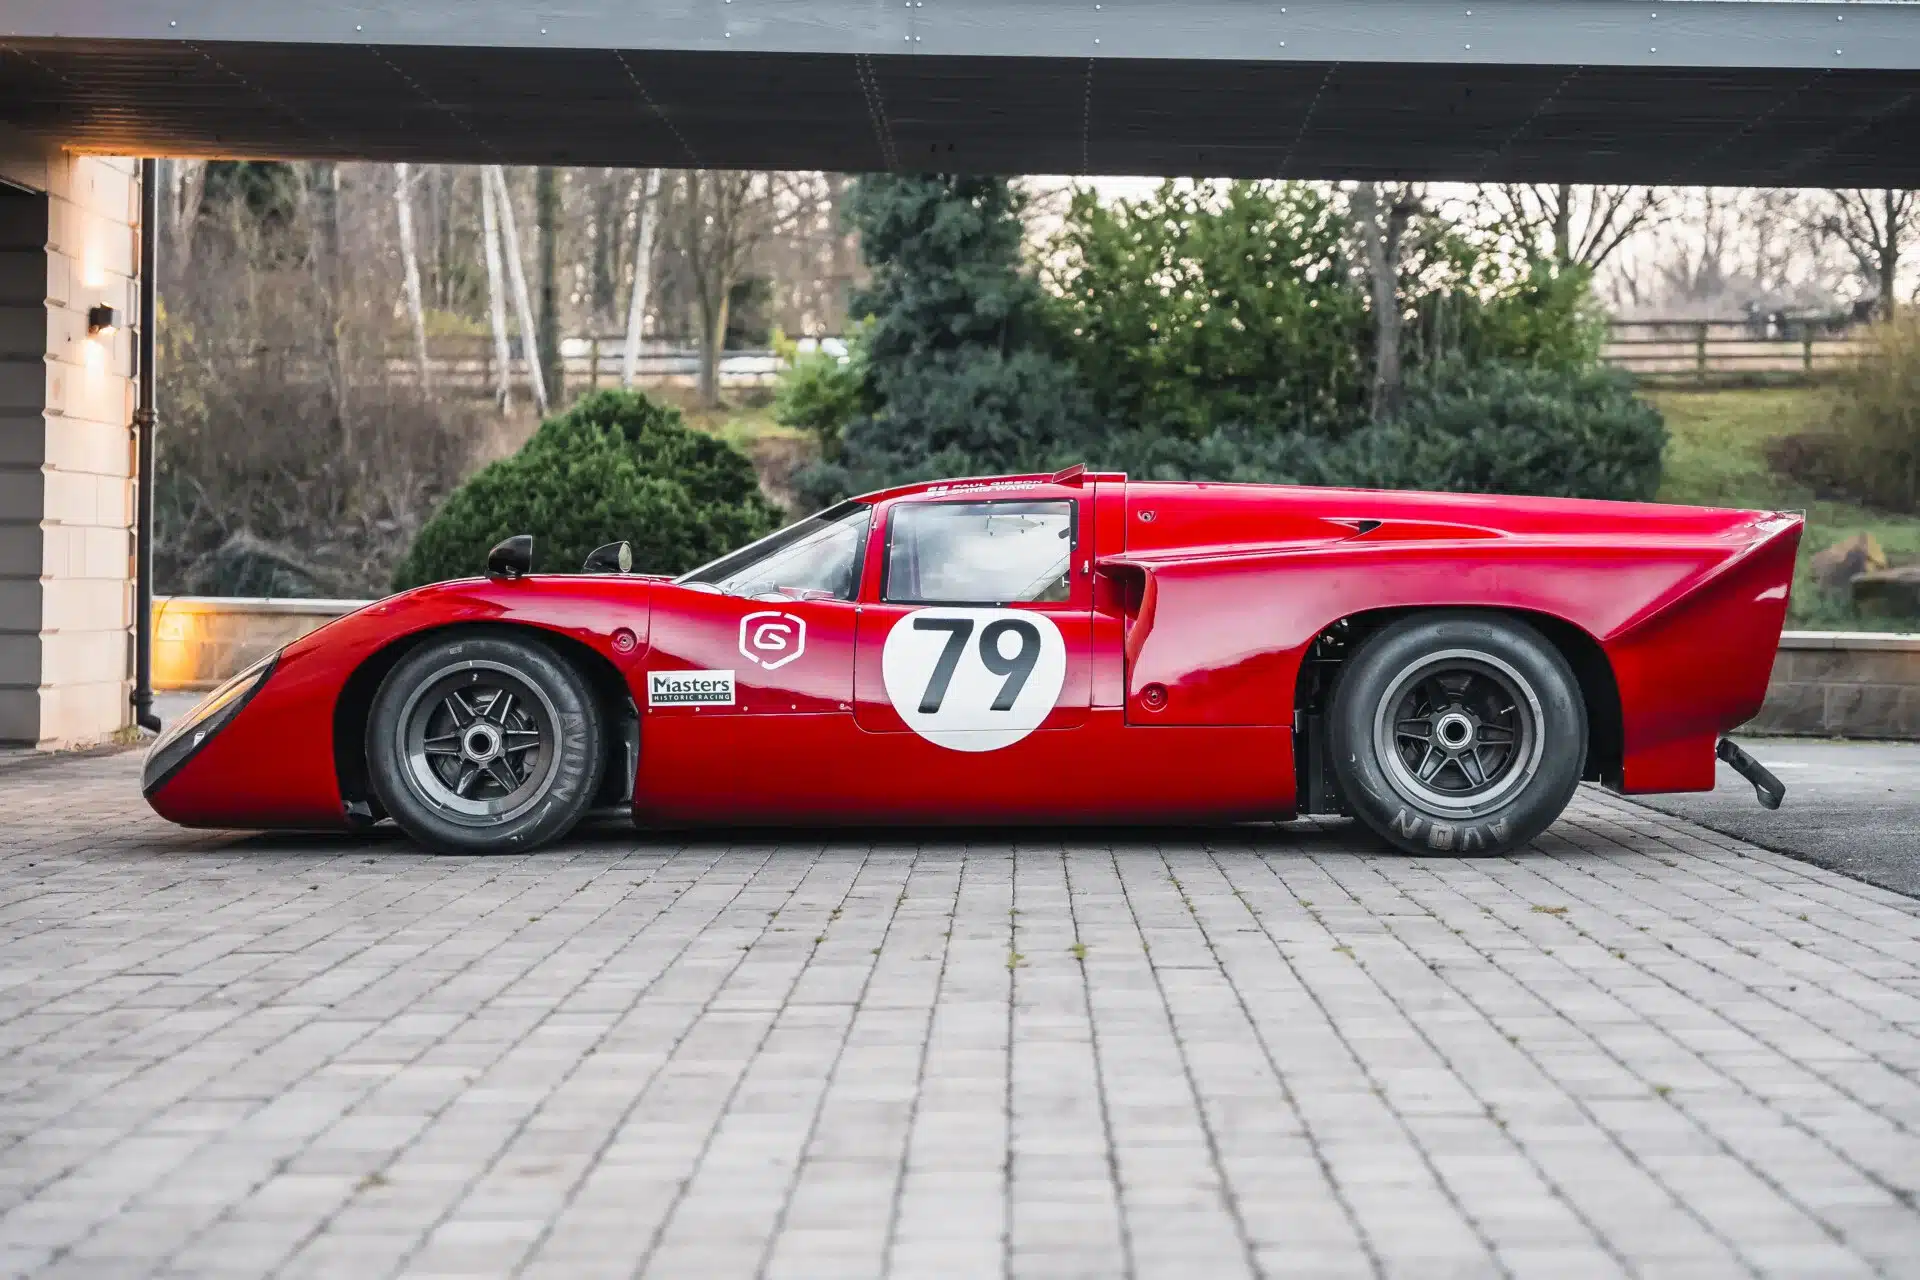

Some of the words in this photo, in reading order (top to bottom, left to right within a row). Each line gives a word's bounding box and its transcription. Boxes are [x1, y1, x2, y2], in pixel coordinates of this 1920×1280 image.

[653, 677, 730, 692] Masters
[913, 618, 1041, 714] 79
[553, 712, 587, 802] AVON
[1389, 808, 1511, 850] AVON
